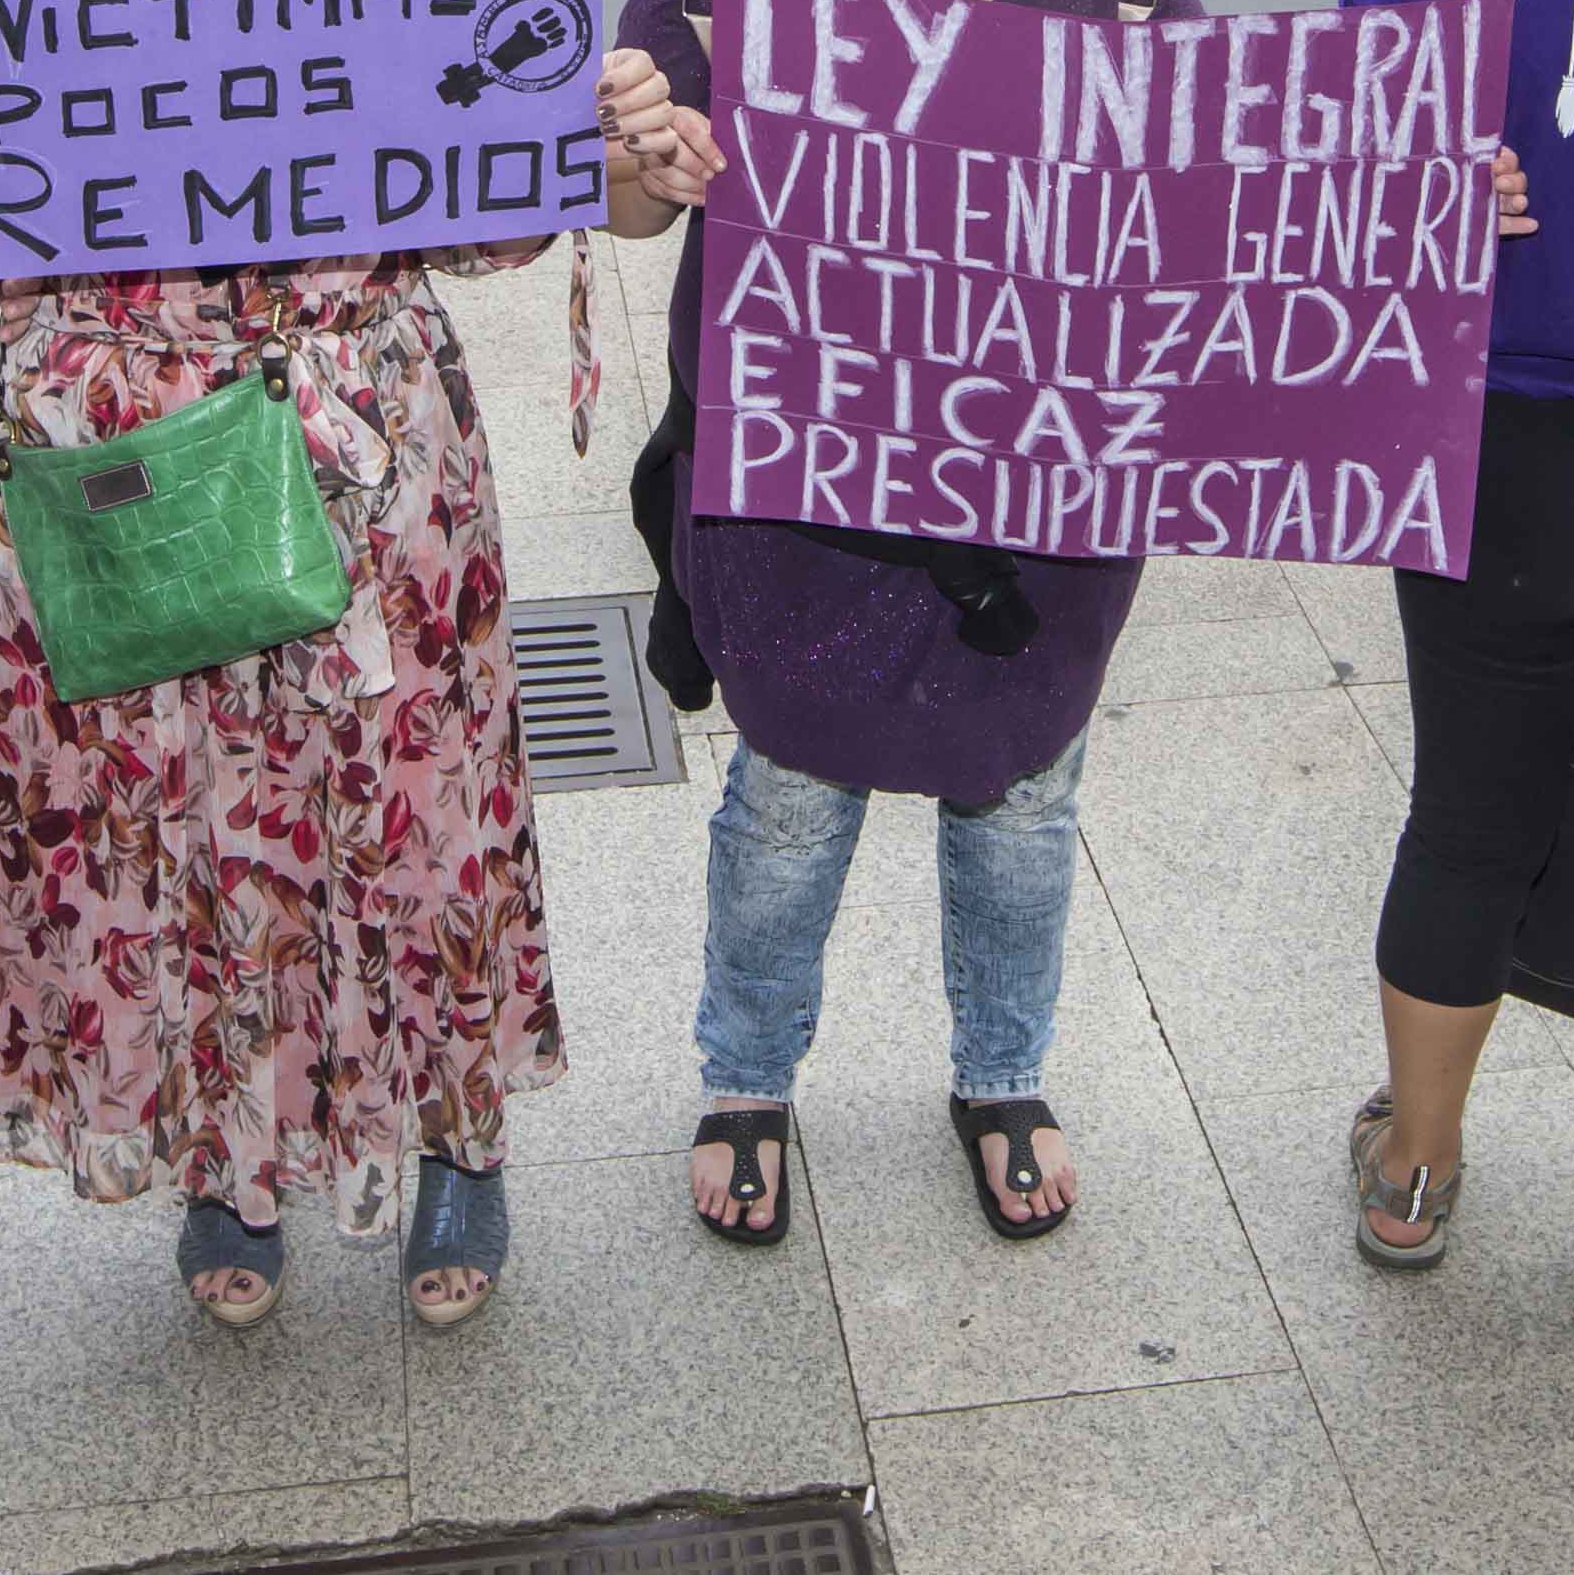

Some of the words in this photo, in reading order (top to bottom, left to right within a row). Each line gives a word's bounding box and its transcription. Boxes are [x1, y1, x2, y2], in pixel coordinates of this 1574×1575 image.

[733, 108, 1161, 287] VIOLENCIA
[717, 236, 1431, 389] ACTUALIZADA
[730, 328, 1168, 466] EFICAZ
[729, 408, 1450, 571] PRESUPUESTADA
